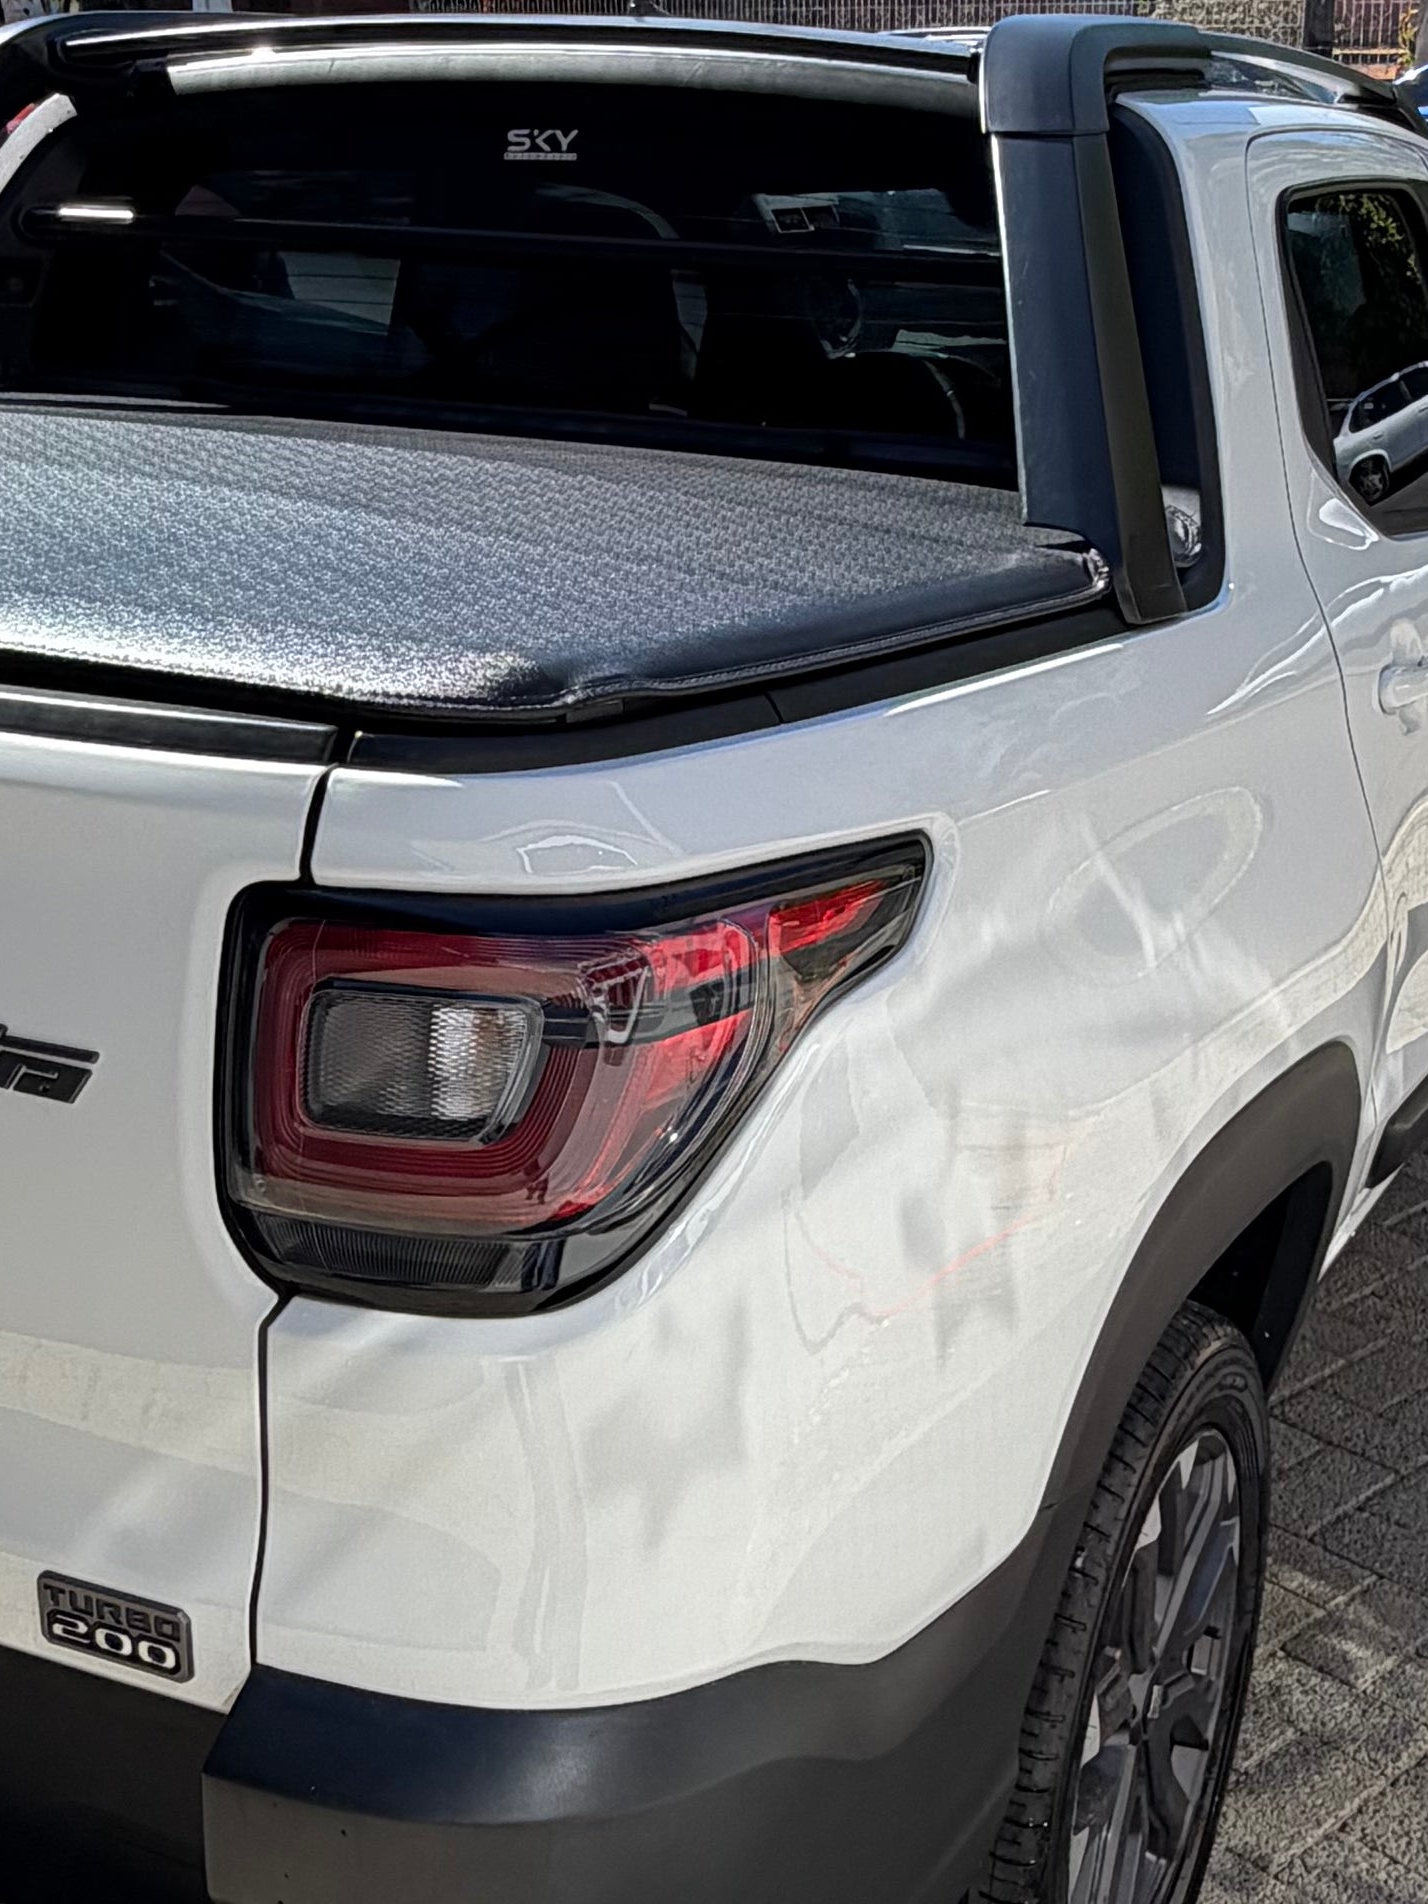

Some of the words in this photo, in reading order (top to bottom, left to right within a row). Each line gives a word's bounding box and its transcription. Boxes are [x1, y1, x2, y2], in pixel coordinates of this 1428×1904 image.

[506, 128, 579, 152] SKY
[43, 1583, 181, 1643] TURBO
[49, 1611, 179, 1673] 200
